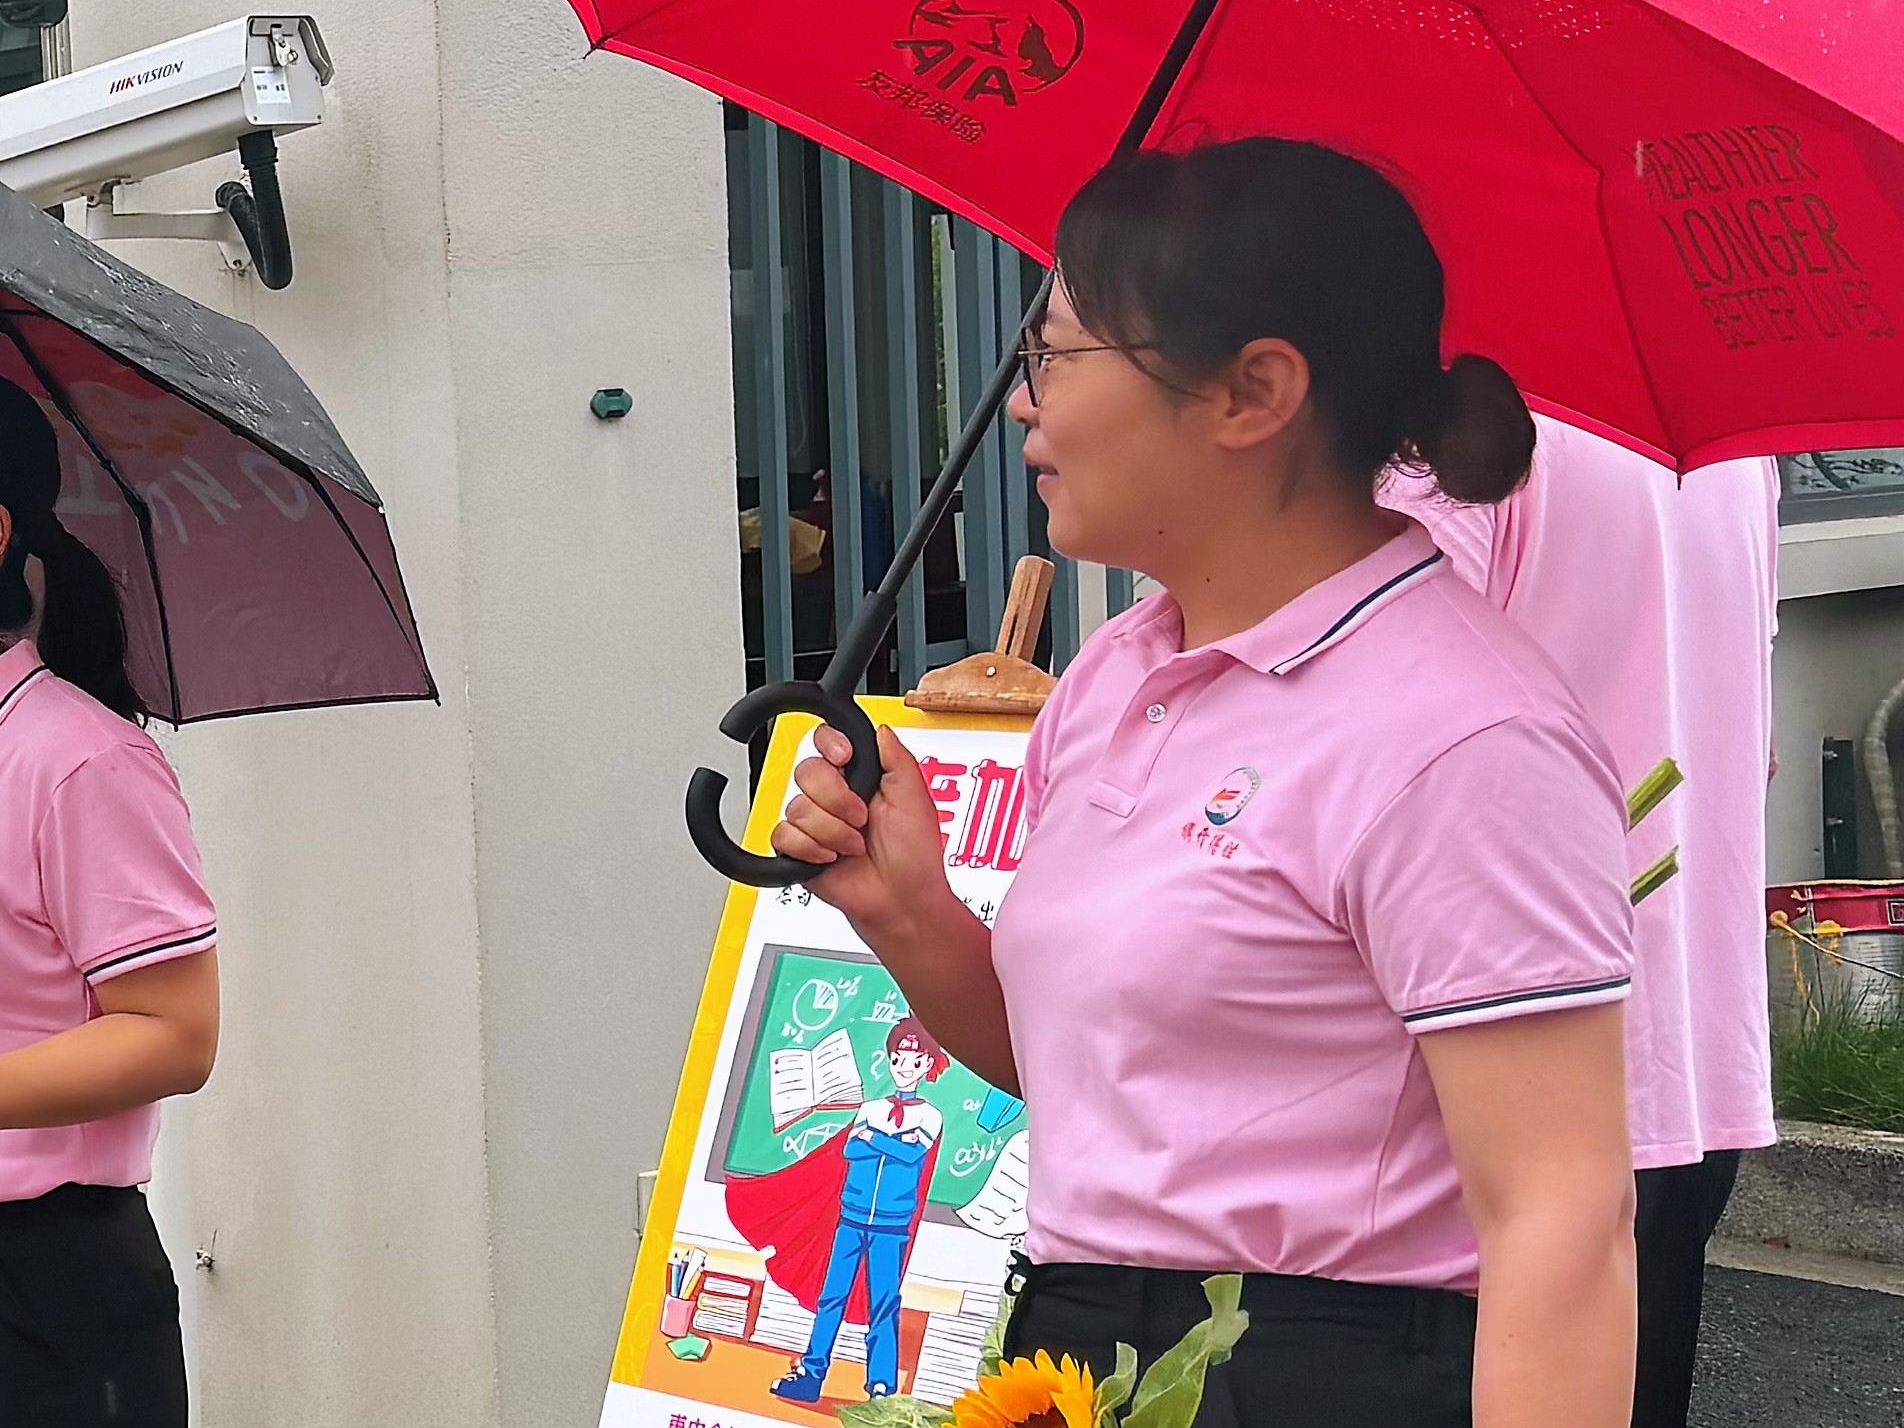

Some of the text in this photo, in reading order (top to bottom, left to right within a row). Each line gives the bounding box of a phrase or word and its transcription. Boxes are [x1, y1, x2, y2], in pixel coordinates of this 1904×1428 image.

[110, 60, 184, 95] HIKVISION
[893, 39, 1017, 106] AIA
[1658, 193, 1862, 290] LONGER
